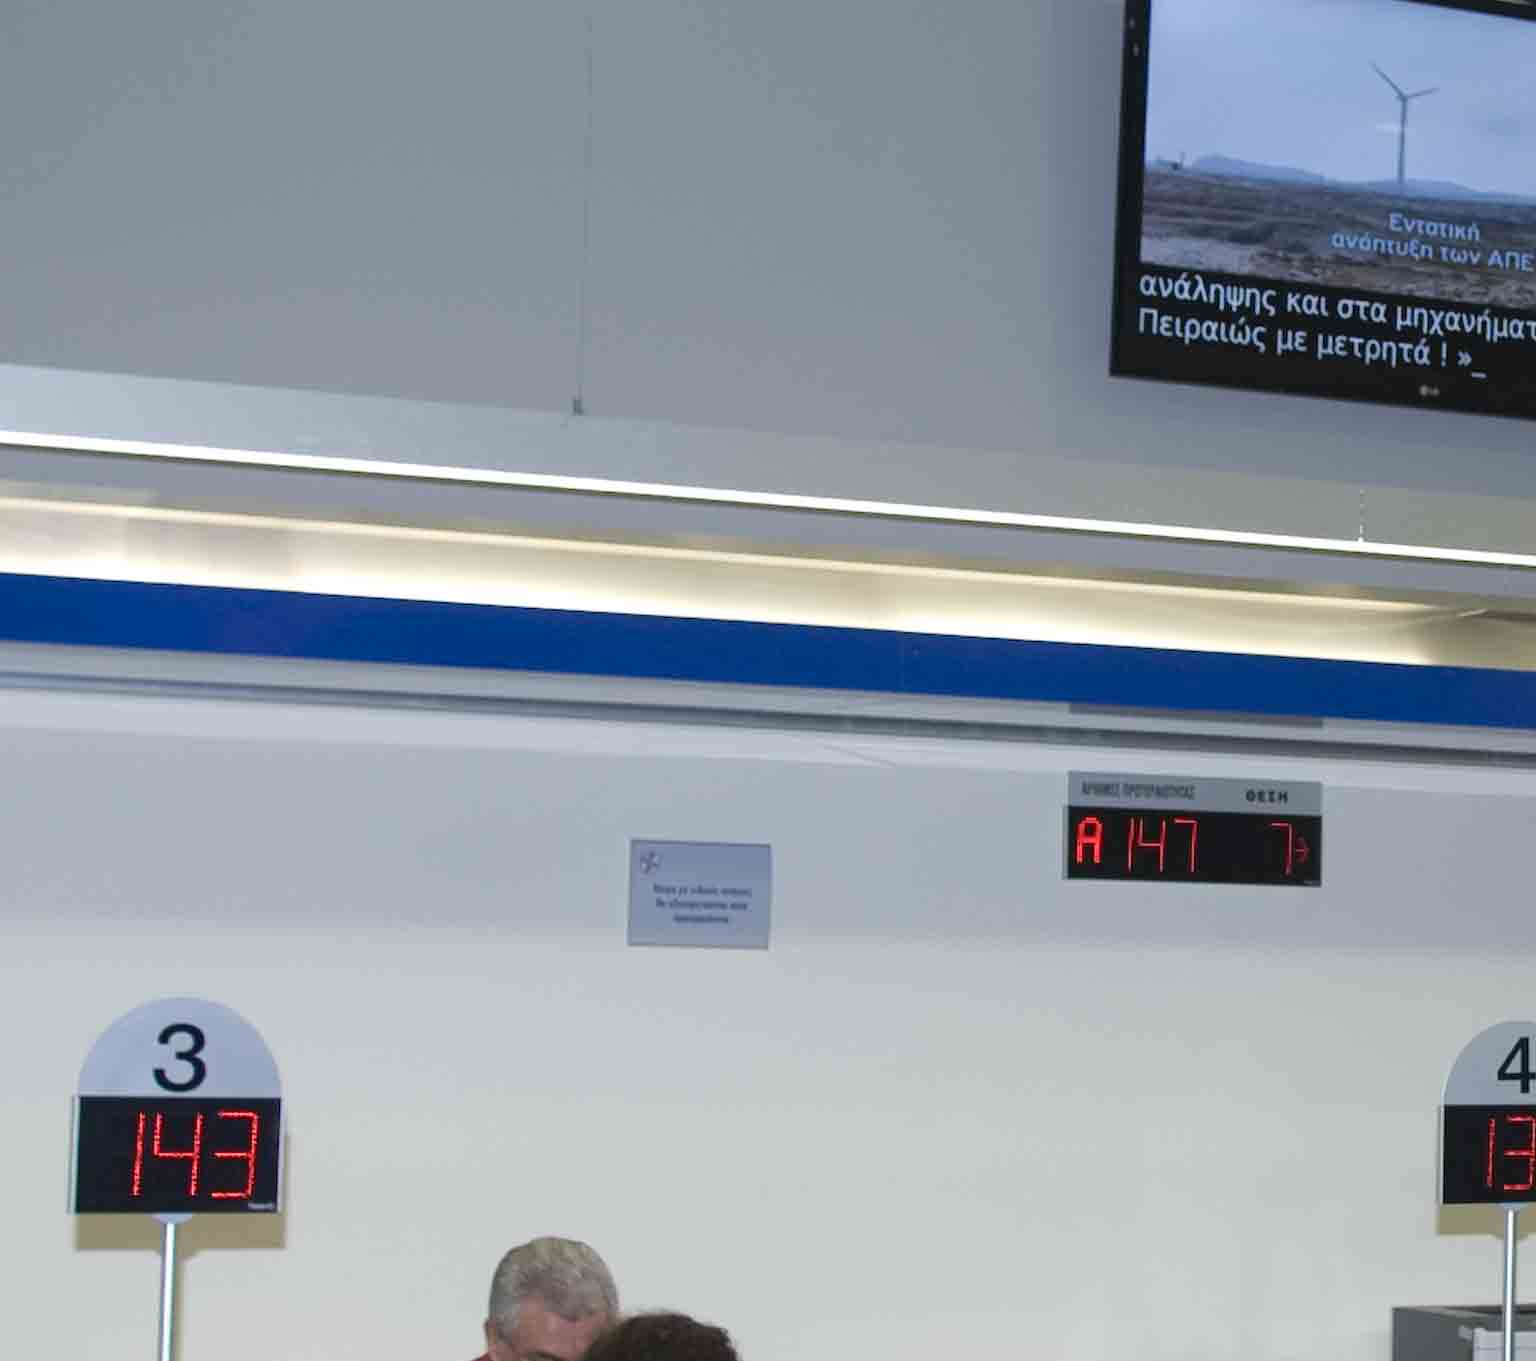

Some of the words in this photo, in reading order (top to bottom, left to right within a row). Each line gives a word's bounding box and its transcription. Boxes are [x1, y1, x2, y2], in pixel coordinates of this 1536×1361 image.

[1331, 231, 1433, 260] ανάπτυξη
[1440, 246, 1481, 265] των
[1488, 250, 1535, 273] ΑΠΕ
[1389, 212, 1480, 241] Εντατική
[1139, 272, 1277, 316] ανάληψης
[1287, 292, 1328, 317] και
[1337, 298, 1387, 323] στα
[1139, 307, 1266, 352] Πειραιώς
[1276, 329, 1308, 355] με
[1317, 333, 1431, 367] μετρητά
[1127, 817, 1199, 873] 147
[153, 1023, 206, 1092] 3
[1497, 1036, 1536, 1094] 4
[131, 1110, 260, 1198] 143
